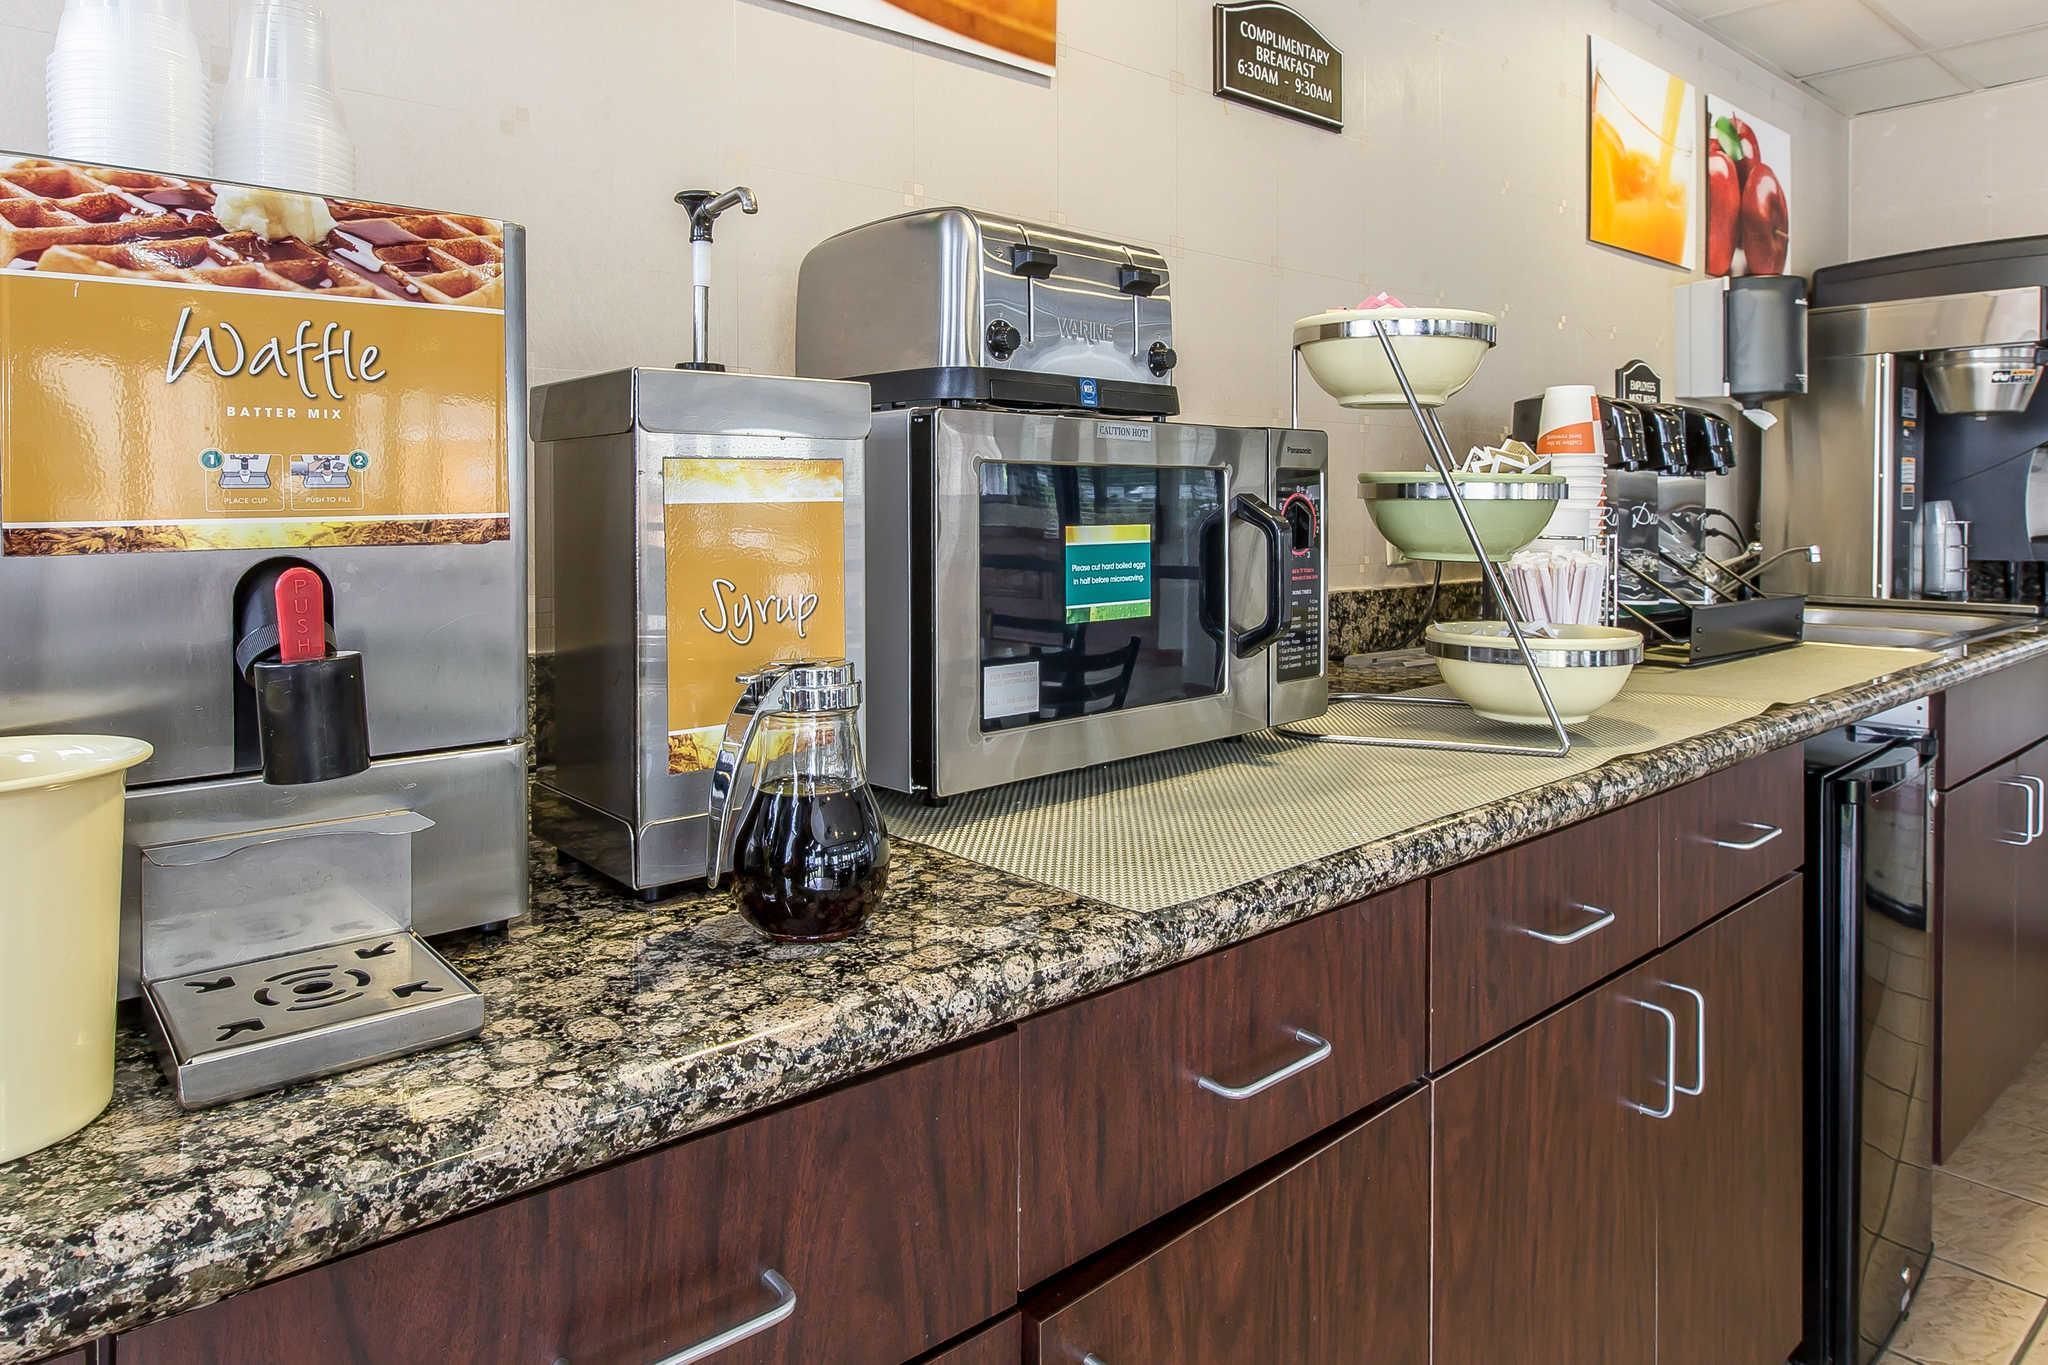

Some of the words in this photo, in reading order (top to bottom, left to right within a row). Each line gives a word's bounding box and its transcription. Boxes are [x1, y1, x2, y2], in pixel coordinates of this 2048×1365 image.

[1240, 21, 1330, 66] COMPLIMENTARY
[1256, 45, 1316, 79] BREAKFAST
[1237, 59, 1279, 86] 6:30AM
[1294, 78, 1333, 103] 9:30AM
[166, 306, 387, 400] Waffle
[226, 406, 296, 419] BATTER
[308, 408, 343, 420] MIX
[1099, 425, 1131, 436] CAUTION
[1132, 428, 1149, 438] HOT!
[1287, 446, 1312, 455] Panasonic
[354, 455, 364, 466] 2
[223, 496, 249, 505] PLACE
[251, 496, 268, 504] CUP
[1071, 564, 1090, 572] Please
[1091, 563, 1100, 571] cut
[1101, 562, 1114, 570] hard
[1132, 562, 1146, 570] eggs
[1079, 577, 1090, 585] half
[1091, 576, 1109, 584] before
[294, 579, 311, 654] PUSH
[699, 578, 819, 645] Syrup
